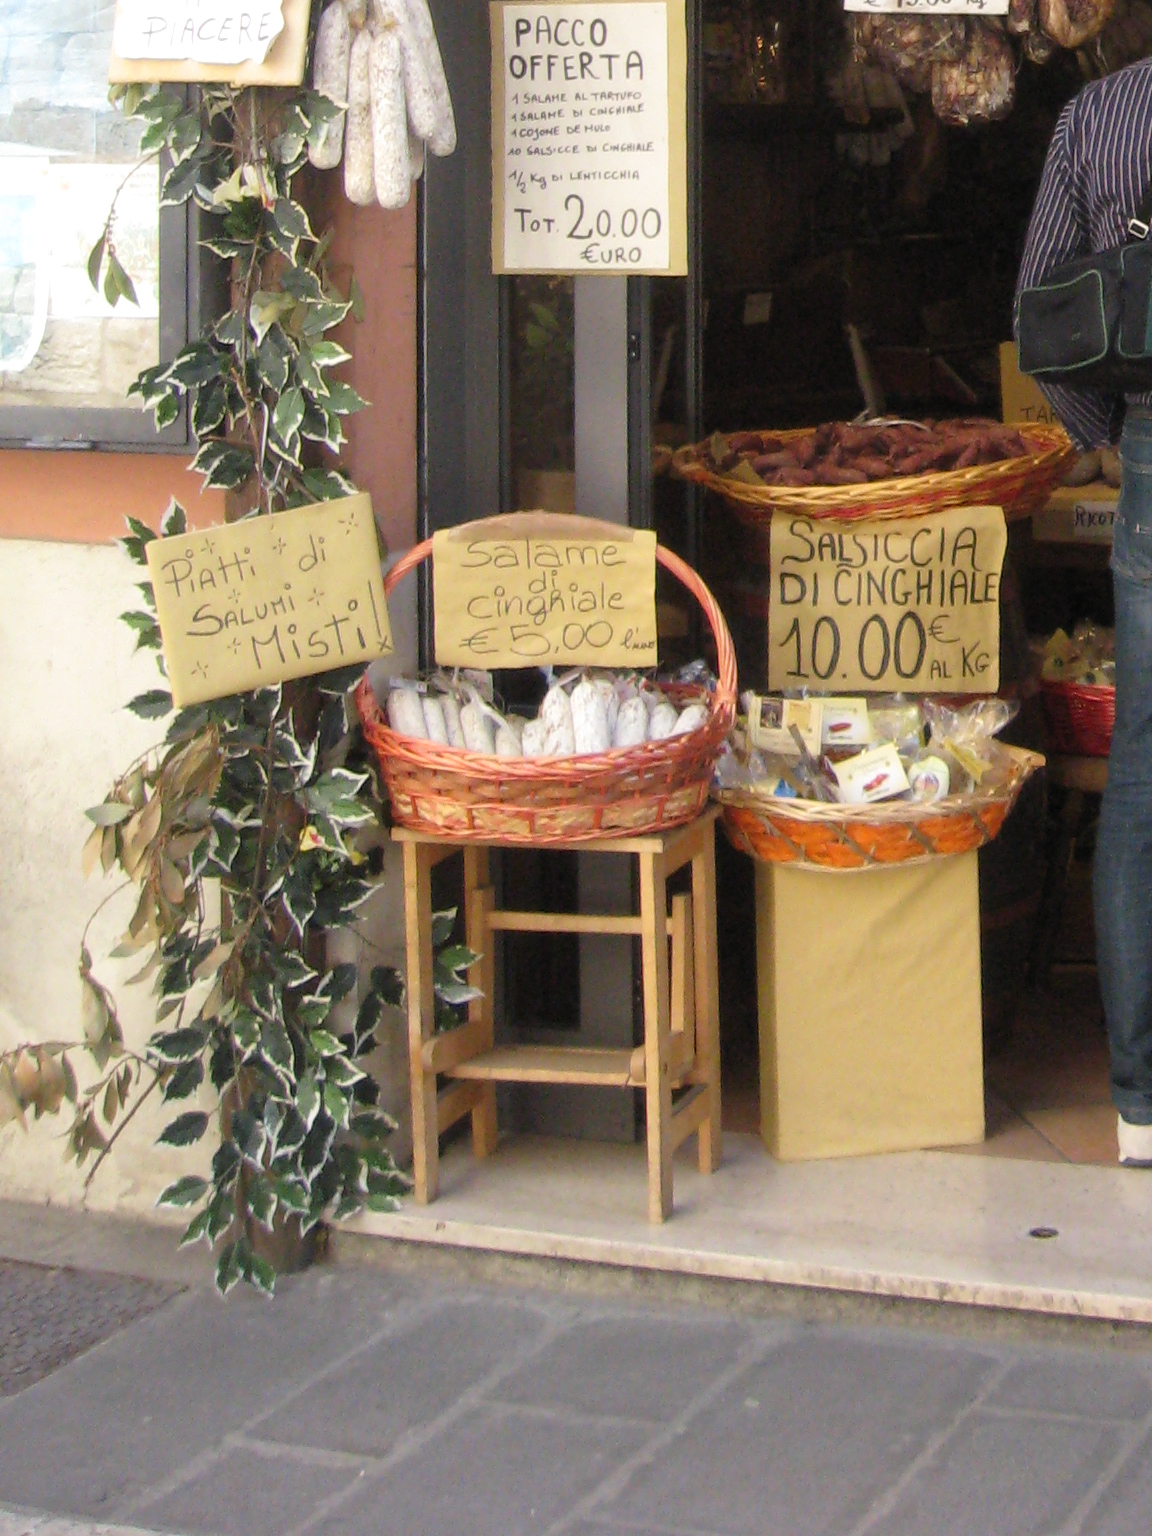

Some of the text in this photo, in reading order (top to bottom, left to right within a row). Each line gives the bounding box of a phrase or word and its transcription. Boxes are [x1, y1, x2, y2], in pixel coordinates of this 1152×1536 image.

[142, 12, 271, 48] PIACERE
[515, 15, 608, 47] PACCO
[509, 50, 643, 81] OFFERTA
[512, 91, 642, 104] 1 SALAME AL TARTUFO
[520, 109, 565, 121] SALAME
[573, 109, 583, 117] DI
[567, 125, 580, 134] DE
[584, 124, 611, 133] MULO
[530, 172, 547, 189] Kg
[551, 173, 563, 181] DI
[569, 170, 640, 181] LENTICCHIA
[564, 194, 662, 239] 20.00
[781, 520, 982, 572] SALSICCIA
[529, 569, 557, 593] di
[779, 565, 999, 608] DI CINGHIALE
[930, 660, 952, 679] AL
